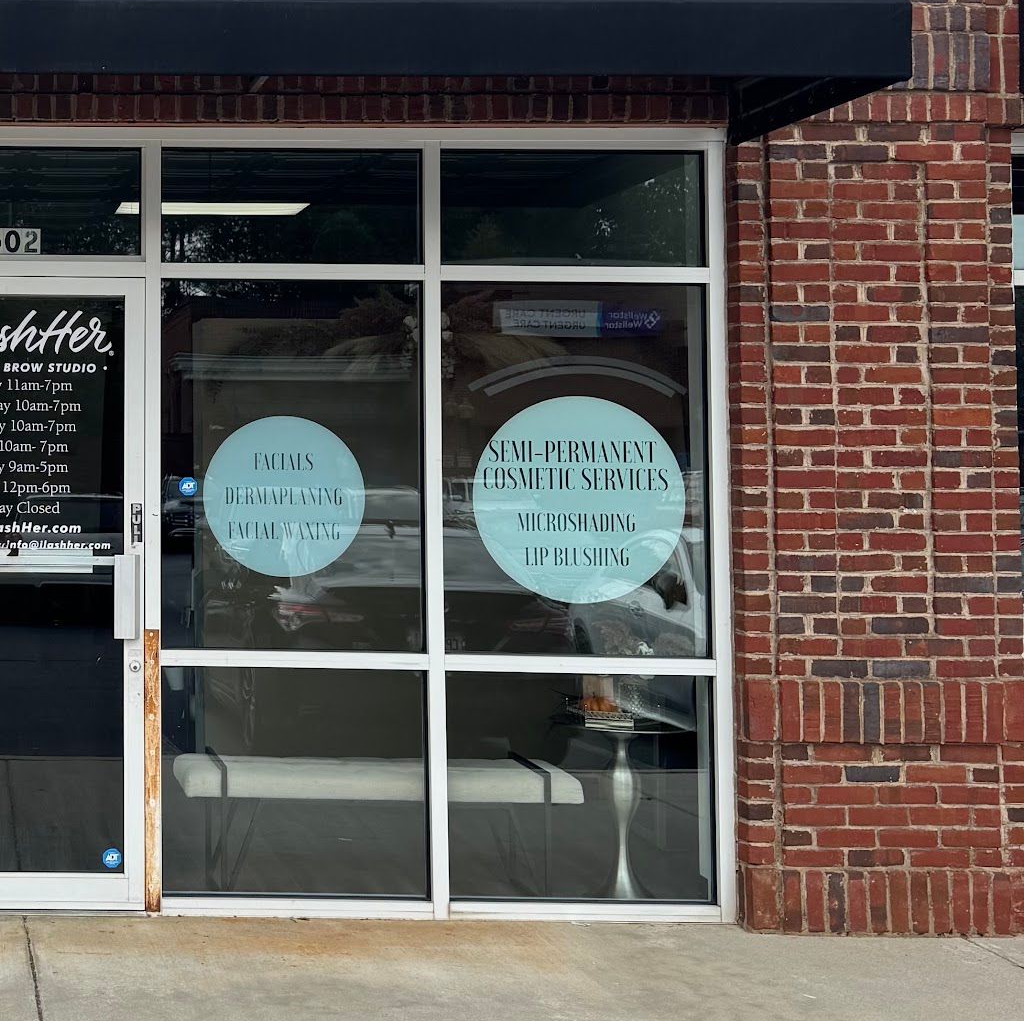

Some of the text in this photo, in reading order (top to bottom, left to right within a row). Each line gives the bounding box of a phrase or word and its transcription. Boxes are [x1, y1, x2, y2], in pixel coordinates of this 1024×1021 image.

[3, 363, 44, 373] BROW
[47, 363, 97, 374] STUDIO
[7, 379, 74, 395] 11am-7pm
[15, 399, 83, 416] 10am-7pm
[11, 419, 78, 436] 10am-7pm
[0, 440, 37, 452] 10am-
[39, 440, 69, 456] 7pm
[488, 439, 658, 463] SEMI-PERMANENT
[8, 460, 69, 477] 9am-5pm
[254, 452, 314, 471] FACIALS
[182, 482, 195, 490] ADT
[483, 467, 669, 491] COSMETIC SERVICES
[3, 481, 72, 498] 12pm-6pm
[225, 486, 344, 506] DERMAPLANING
[16, 500, 61, 514] Closed
[228, 521, 341, 541] FACIAL WAXING
[517, 512, 636, 533] MICROSHADING
[525, 546, 630, 567] LIP BLUSHING
